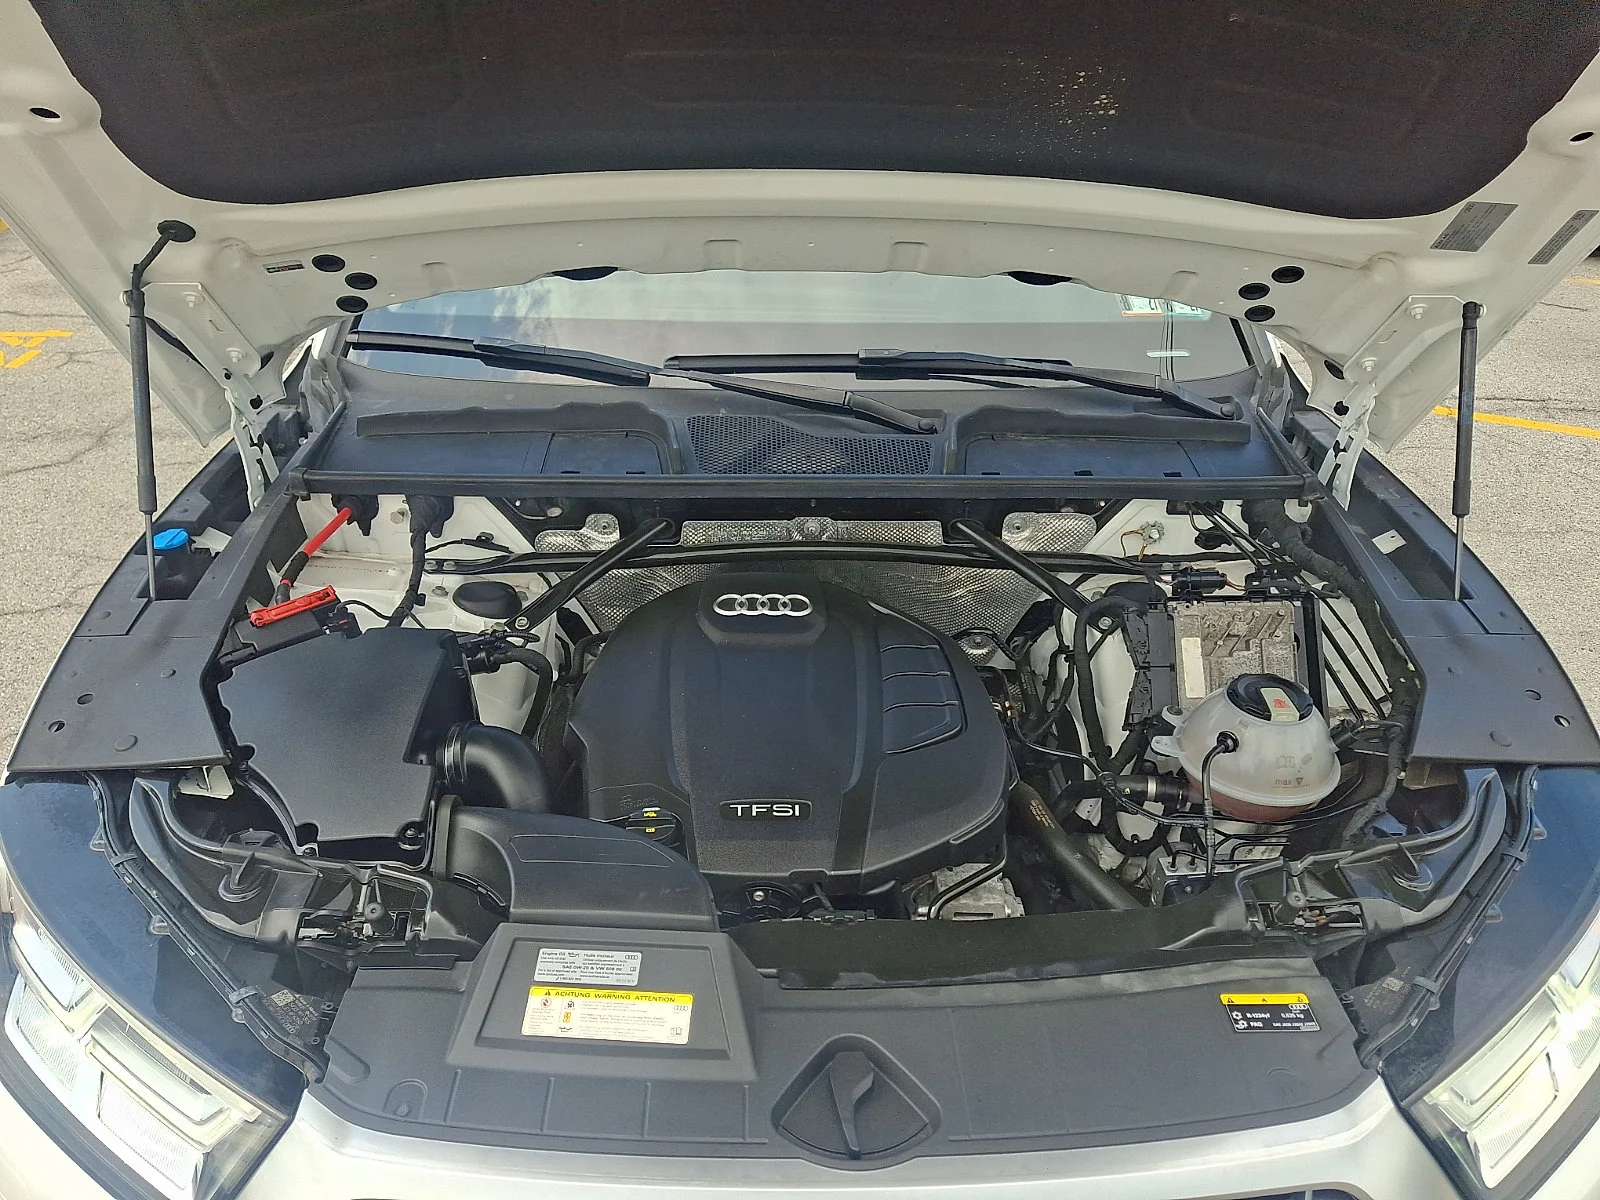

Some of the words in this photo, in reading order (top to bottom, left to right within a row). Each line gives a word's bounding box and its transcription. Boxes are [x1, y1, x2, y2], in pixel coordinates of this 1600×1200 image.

[729, 804, 800, 817] TFSI
[554, 991, 591, 999] ACHTUNG
[634, 995, 676, 1003] ATTENTION
